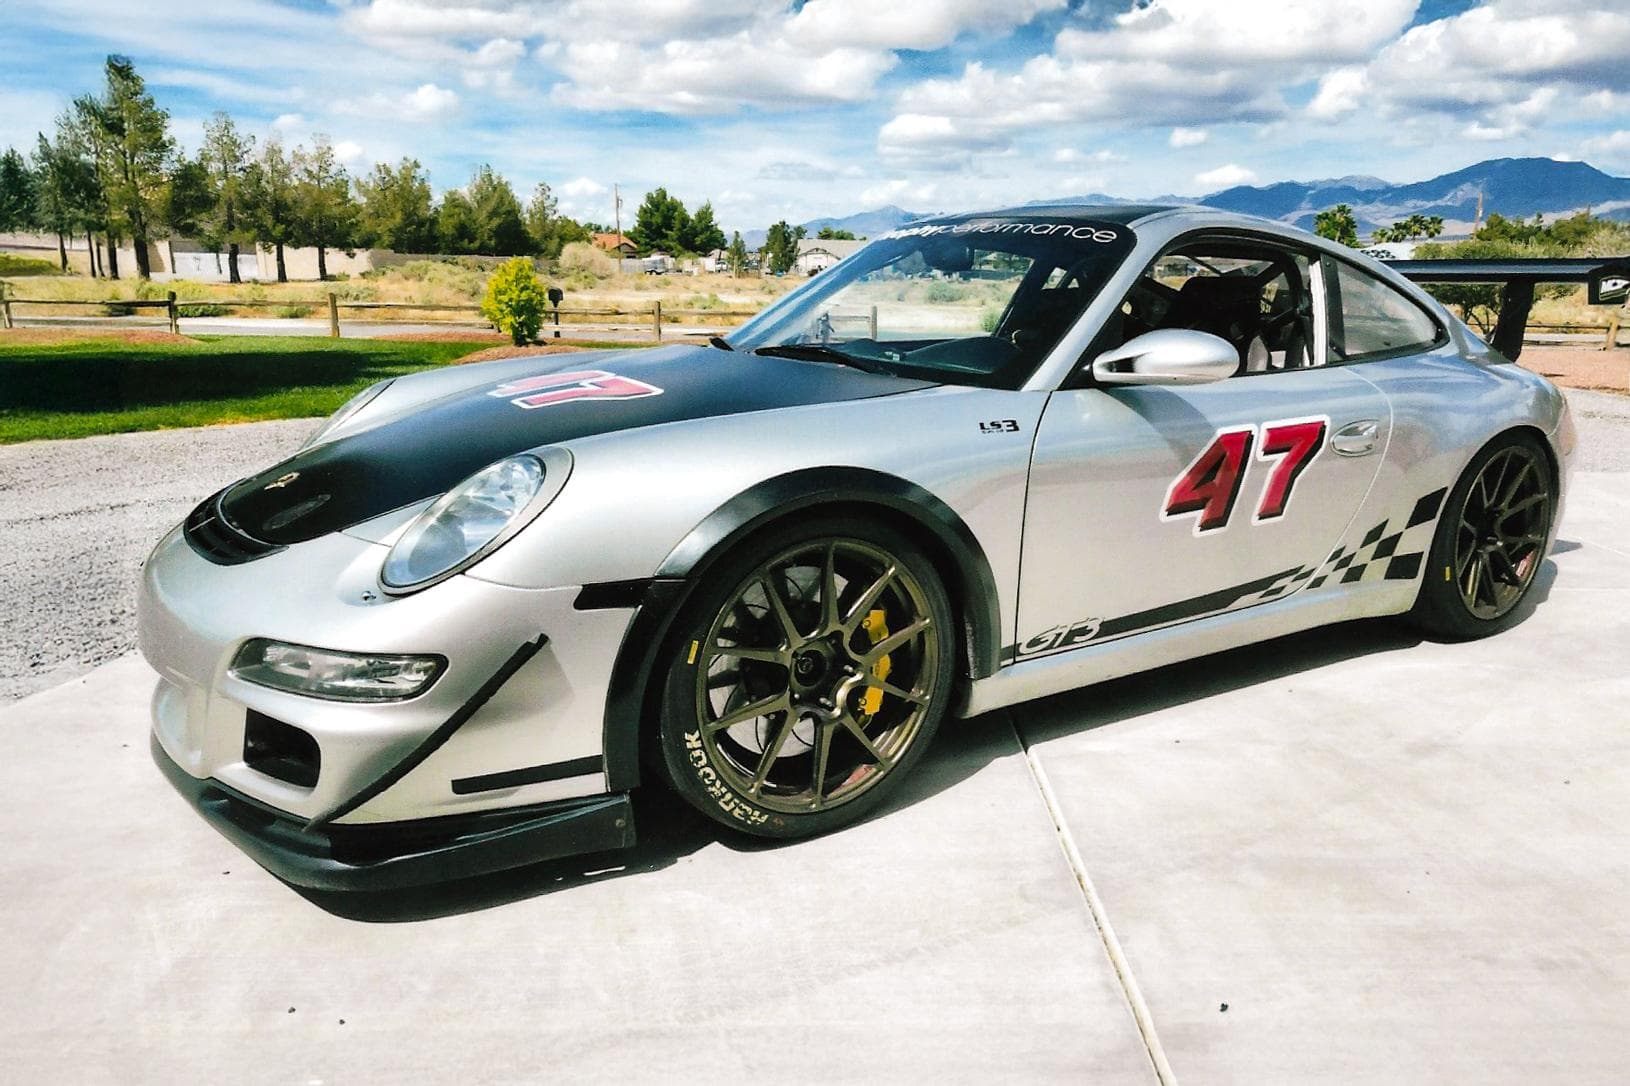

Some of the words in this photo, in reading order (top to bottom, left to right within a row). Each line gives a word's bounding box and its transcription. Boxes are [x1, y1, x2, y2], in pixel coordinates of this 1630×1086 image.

[979, 419, 1020, 433] LS3
[1159, 414, 1331, 537] 47
[1018, 617, 1104, 654] GT3
